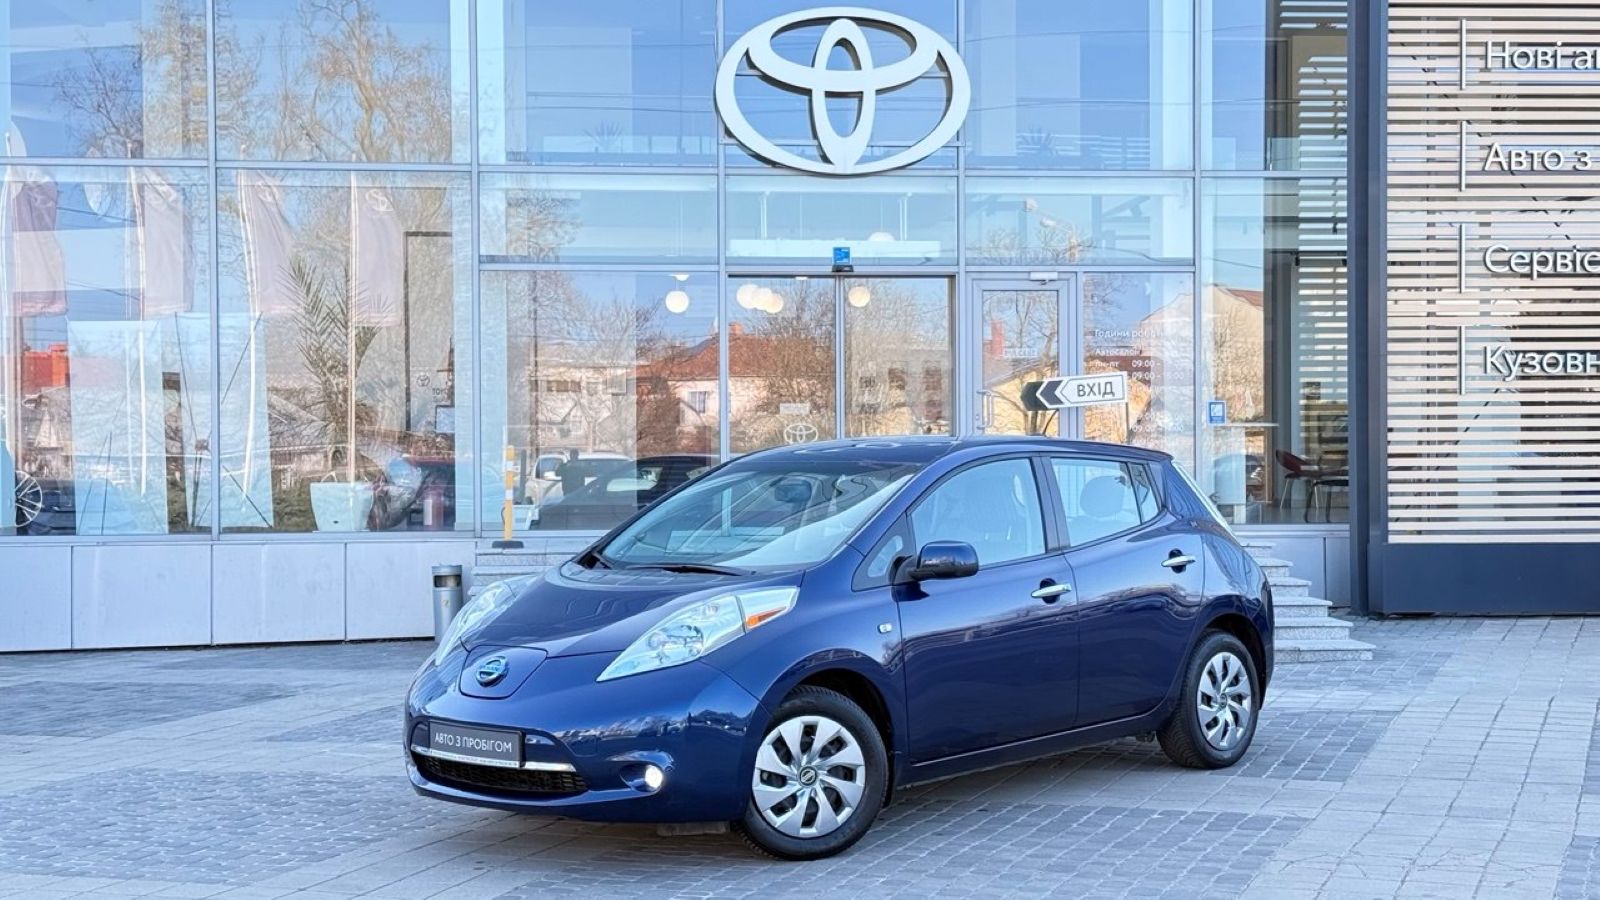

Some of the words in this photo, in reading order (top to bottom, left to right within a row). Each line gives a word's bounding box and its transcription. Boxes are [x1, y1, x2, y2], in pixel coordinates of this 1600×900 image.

[1485, 40, 1562, 69] Нові
[1572, 49, 1600, 69] а
[1483, 142, 1563, 170] Авто
[1573, 150, 1592, 170] з
[1484, 244, 1600, 280] Сервіс
[1076, 381, 1115, 398] ВХІД
[435, 732, 454, 746] АВТО
[462, 736, 512, 753] ПРОБІГОМ
